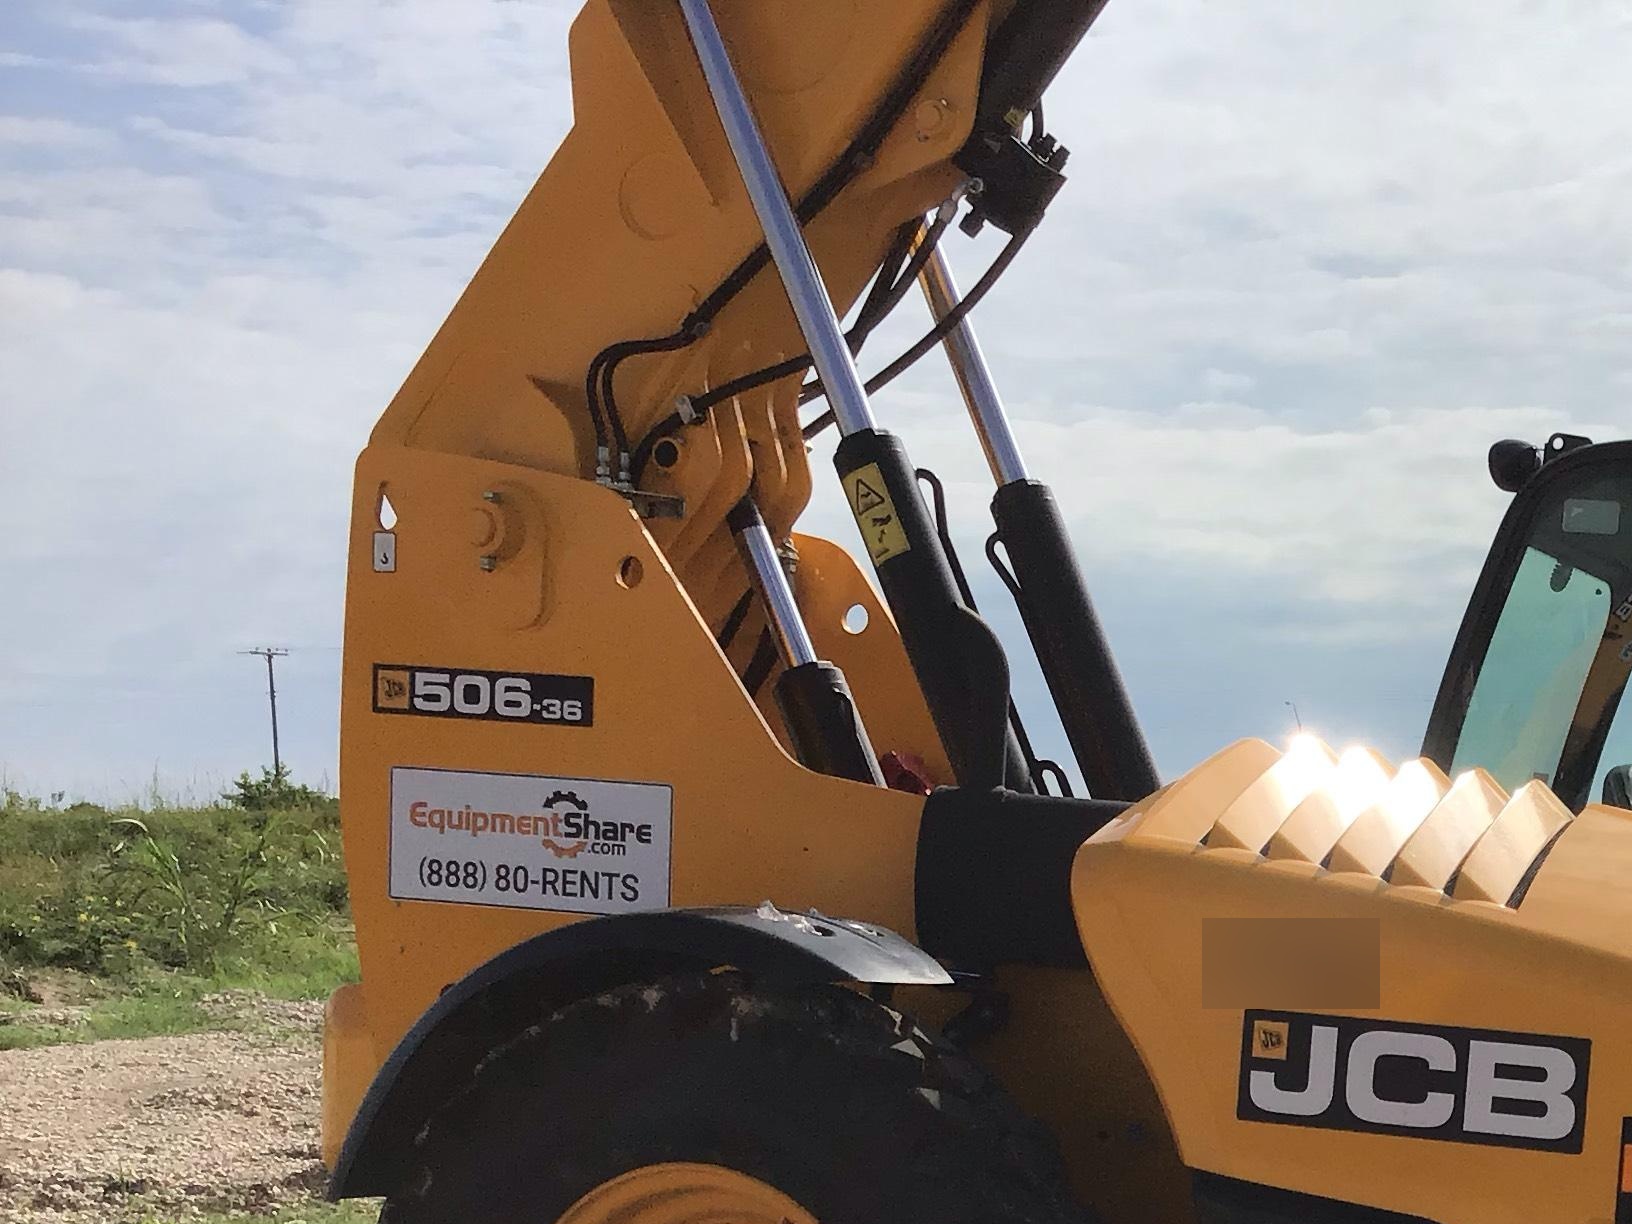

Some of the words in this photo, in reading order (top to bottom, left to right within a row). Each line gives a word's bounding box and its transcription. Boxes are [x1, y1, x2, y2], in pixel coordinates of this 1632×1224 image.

[413, 671, 583, 721] 506-36
[409, 801, 653, 844] EquipmentShare
[587, 841, 627, 857] .com
[419, 856, 487, 892] (888)
[494, 863, 640, 902] 80-RENTS
[1249, 1025, 1577, 1141] JCB
